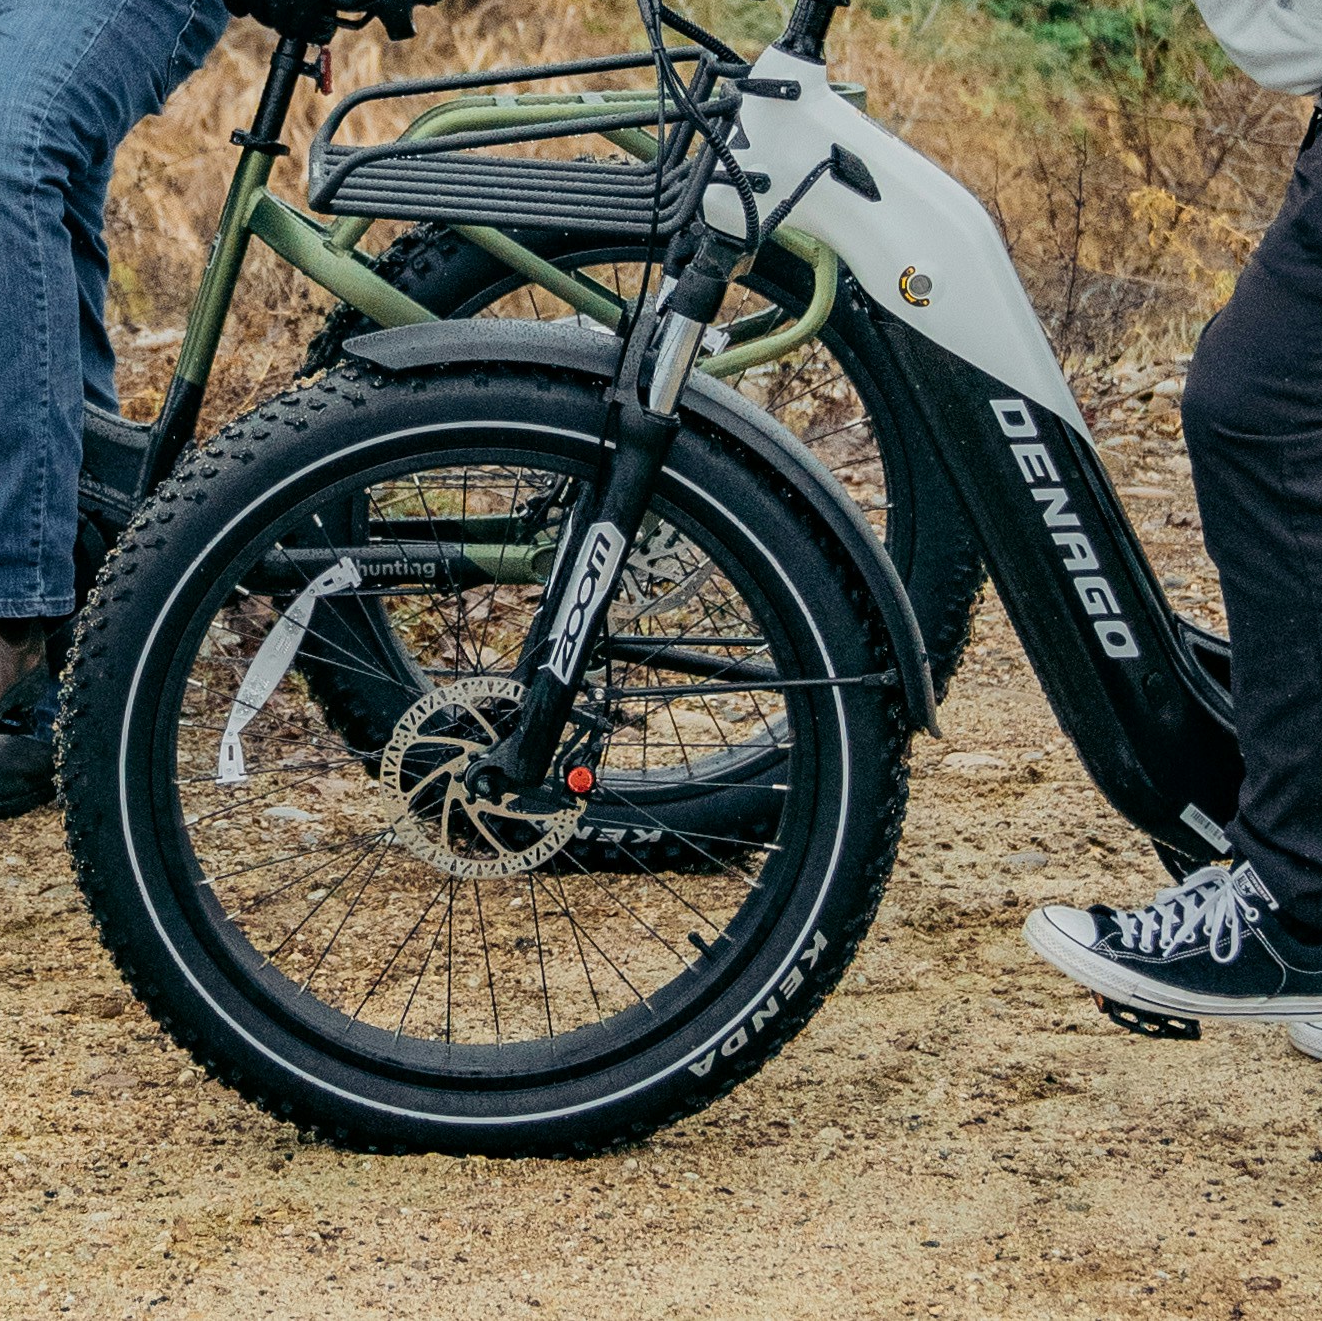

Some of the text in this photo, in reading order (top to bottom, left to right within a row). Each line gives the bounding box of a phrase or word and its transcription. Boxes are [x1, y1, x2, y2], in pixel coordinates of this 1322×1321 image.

[356, 558, 436, 578] hunting
[989, 399, 1139, 658] DENAGO
[688, 930, 828, 1077] KENDA
